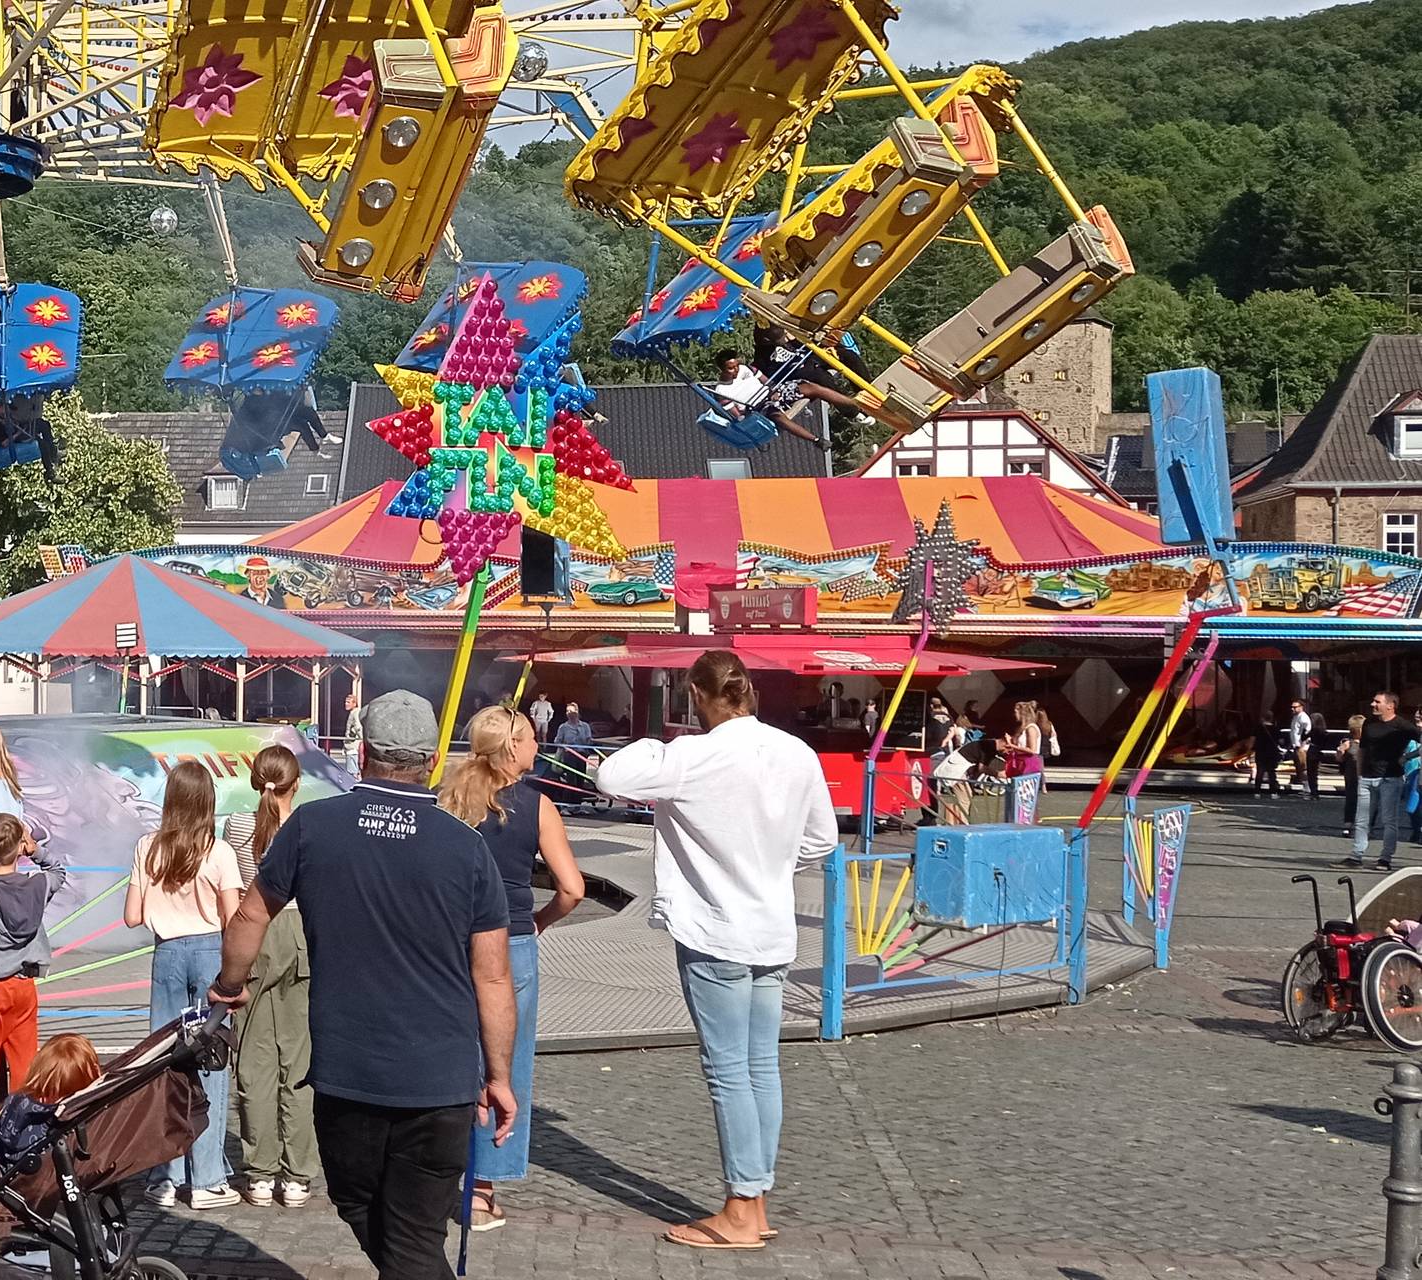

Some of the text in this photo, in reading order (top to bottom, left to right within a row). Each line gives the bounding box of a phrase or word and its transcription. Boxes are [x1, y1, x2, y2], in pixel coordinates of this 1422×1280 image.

[433, 381, 547, 448] TAI
[428, 439, 556, 518] FUN
[358, 817, 417, 834] CAMP DAVID
[366, 803, 393, 812] CREW
[391, 807, 416, 824] 63
[366, 829, 407, 840] AVIATION
[61, 1173, 80, 1202] Joie
